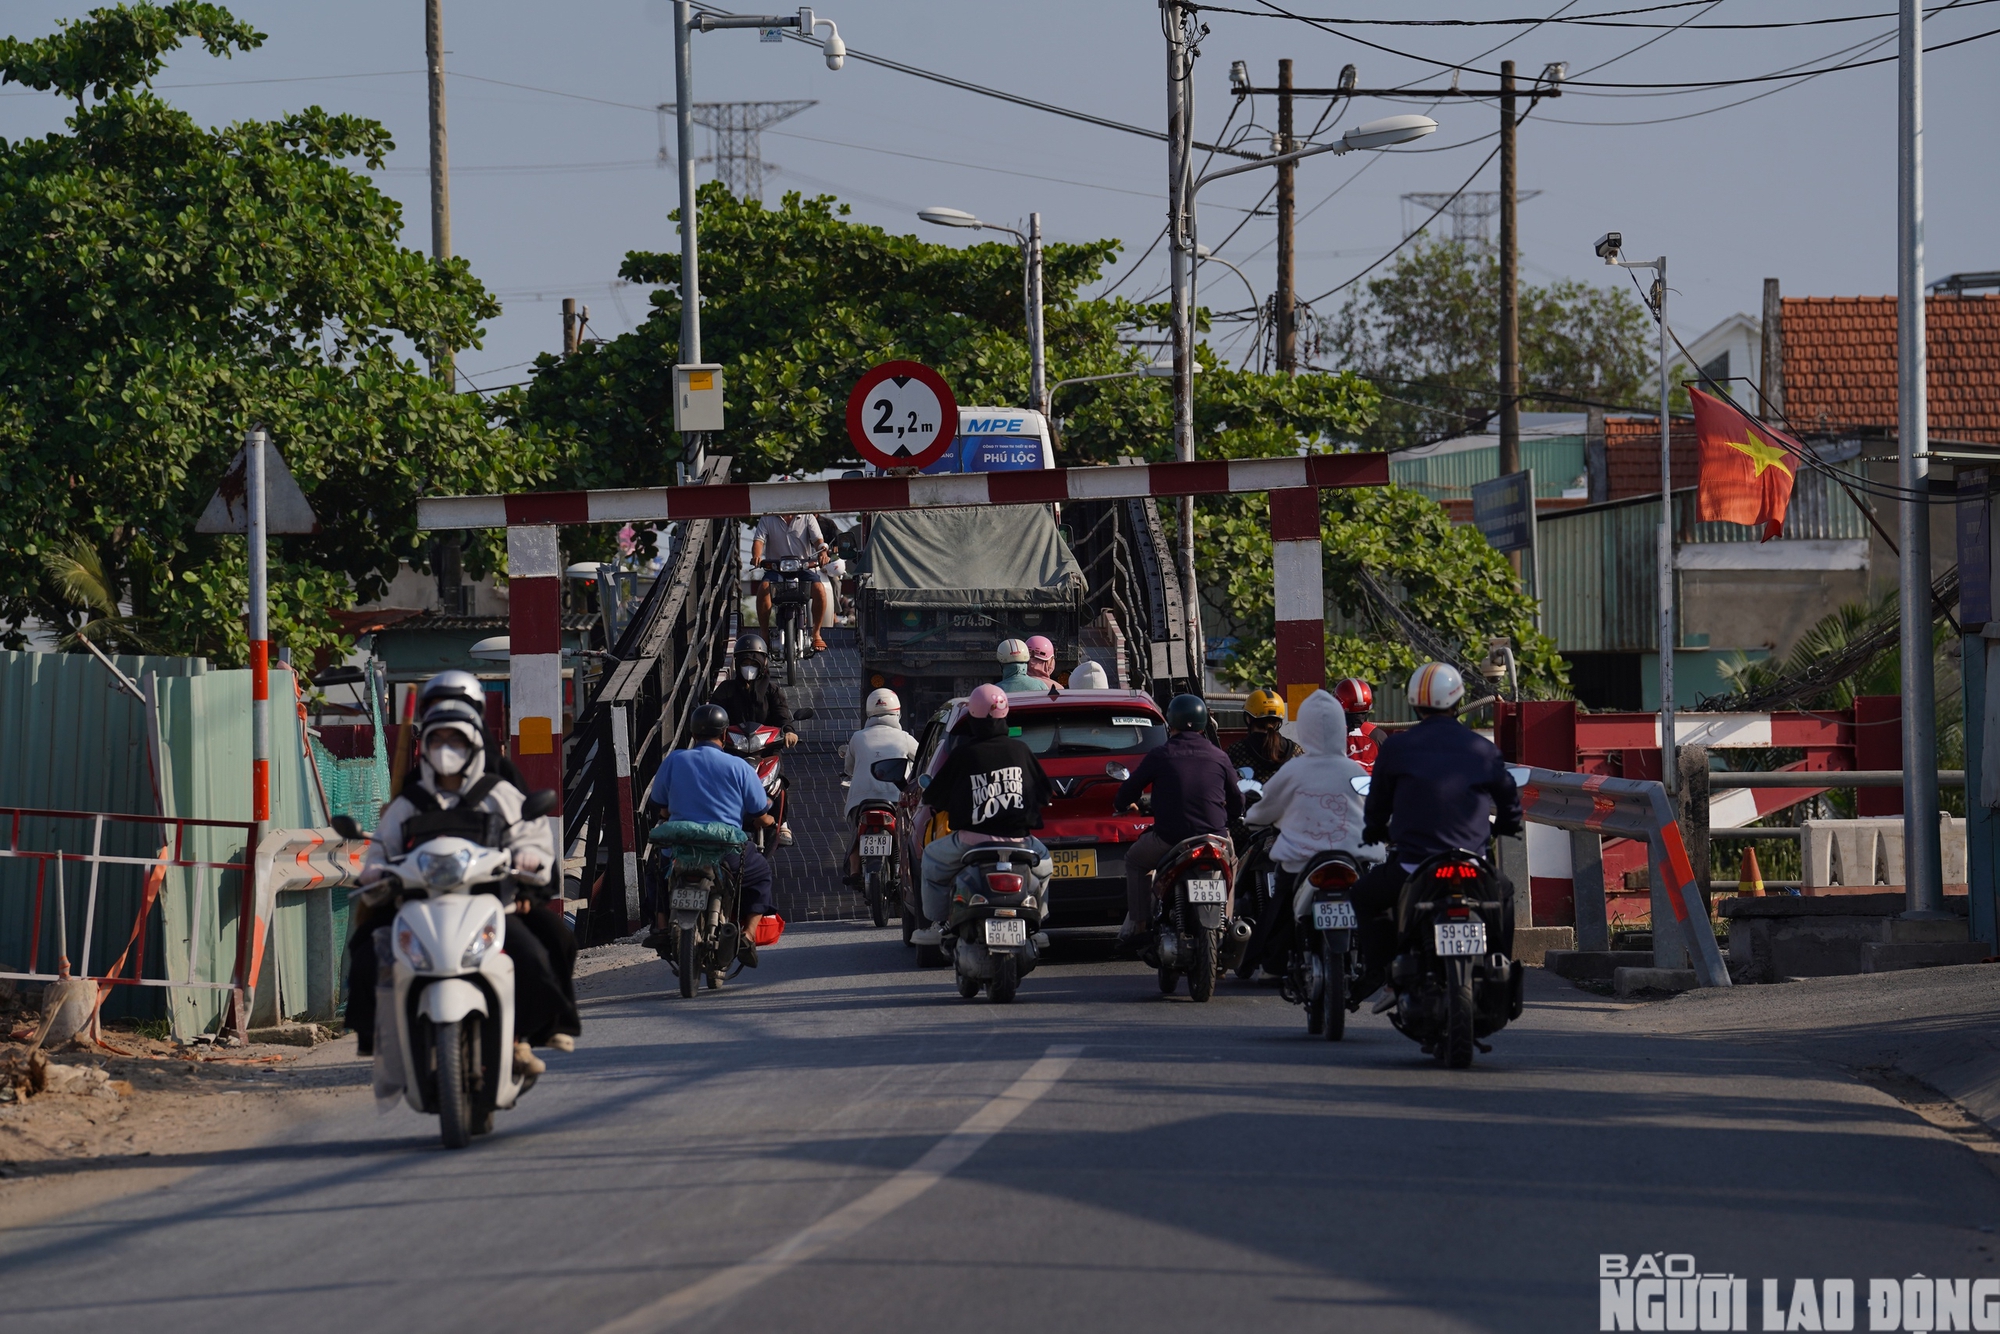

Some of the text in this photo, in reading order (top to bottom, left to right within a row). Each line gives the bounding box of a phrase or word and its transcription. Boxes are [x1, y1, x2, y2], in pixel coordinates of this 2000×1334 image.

[967, 419, 1023, 432] MPE
[984, 451, 1036, 465] PHÚ LỘC
[970, 767, 1023, 790] IN THE
[973, 780, 1023, 809] MOOD FOR
[972, 793, 1024, 825] LOVE
[1054, 851, 1079, 863] 50H
[1053, 865, 1089, 877] 30.17
[1194, 892, 1221, 902] 2859
[1317, 916, 1356, 927] 097.00
